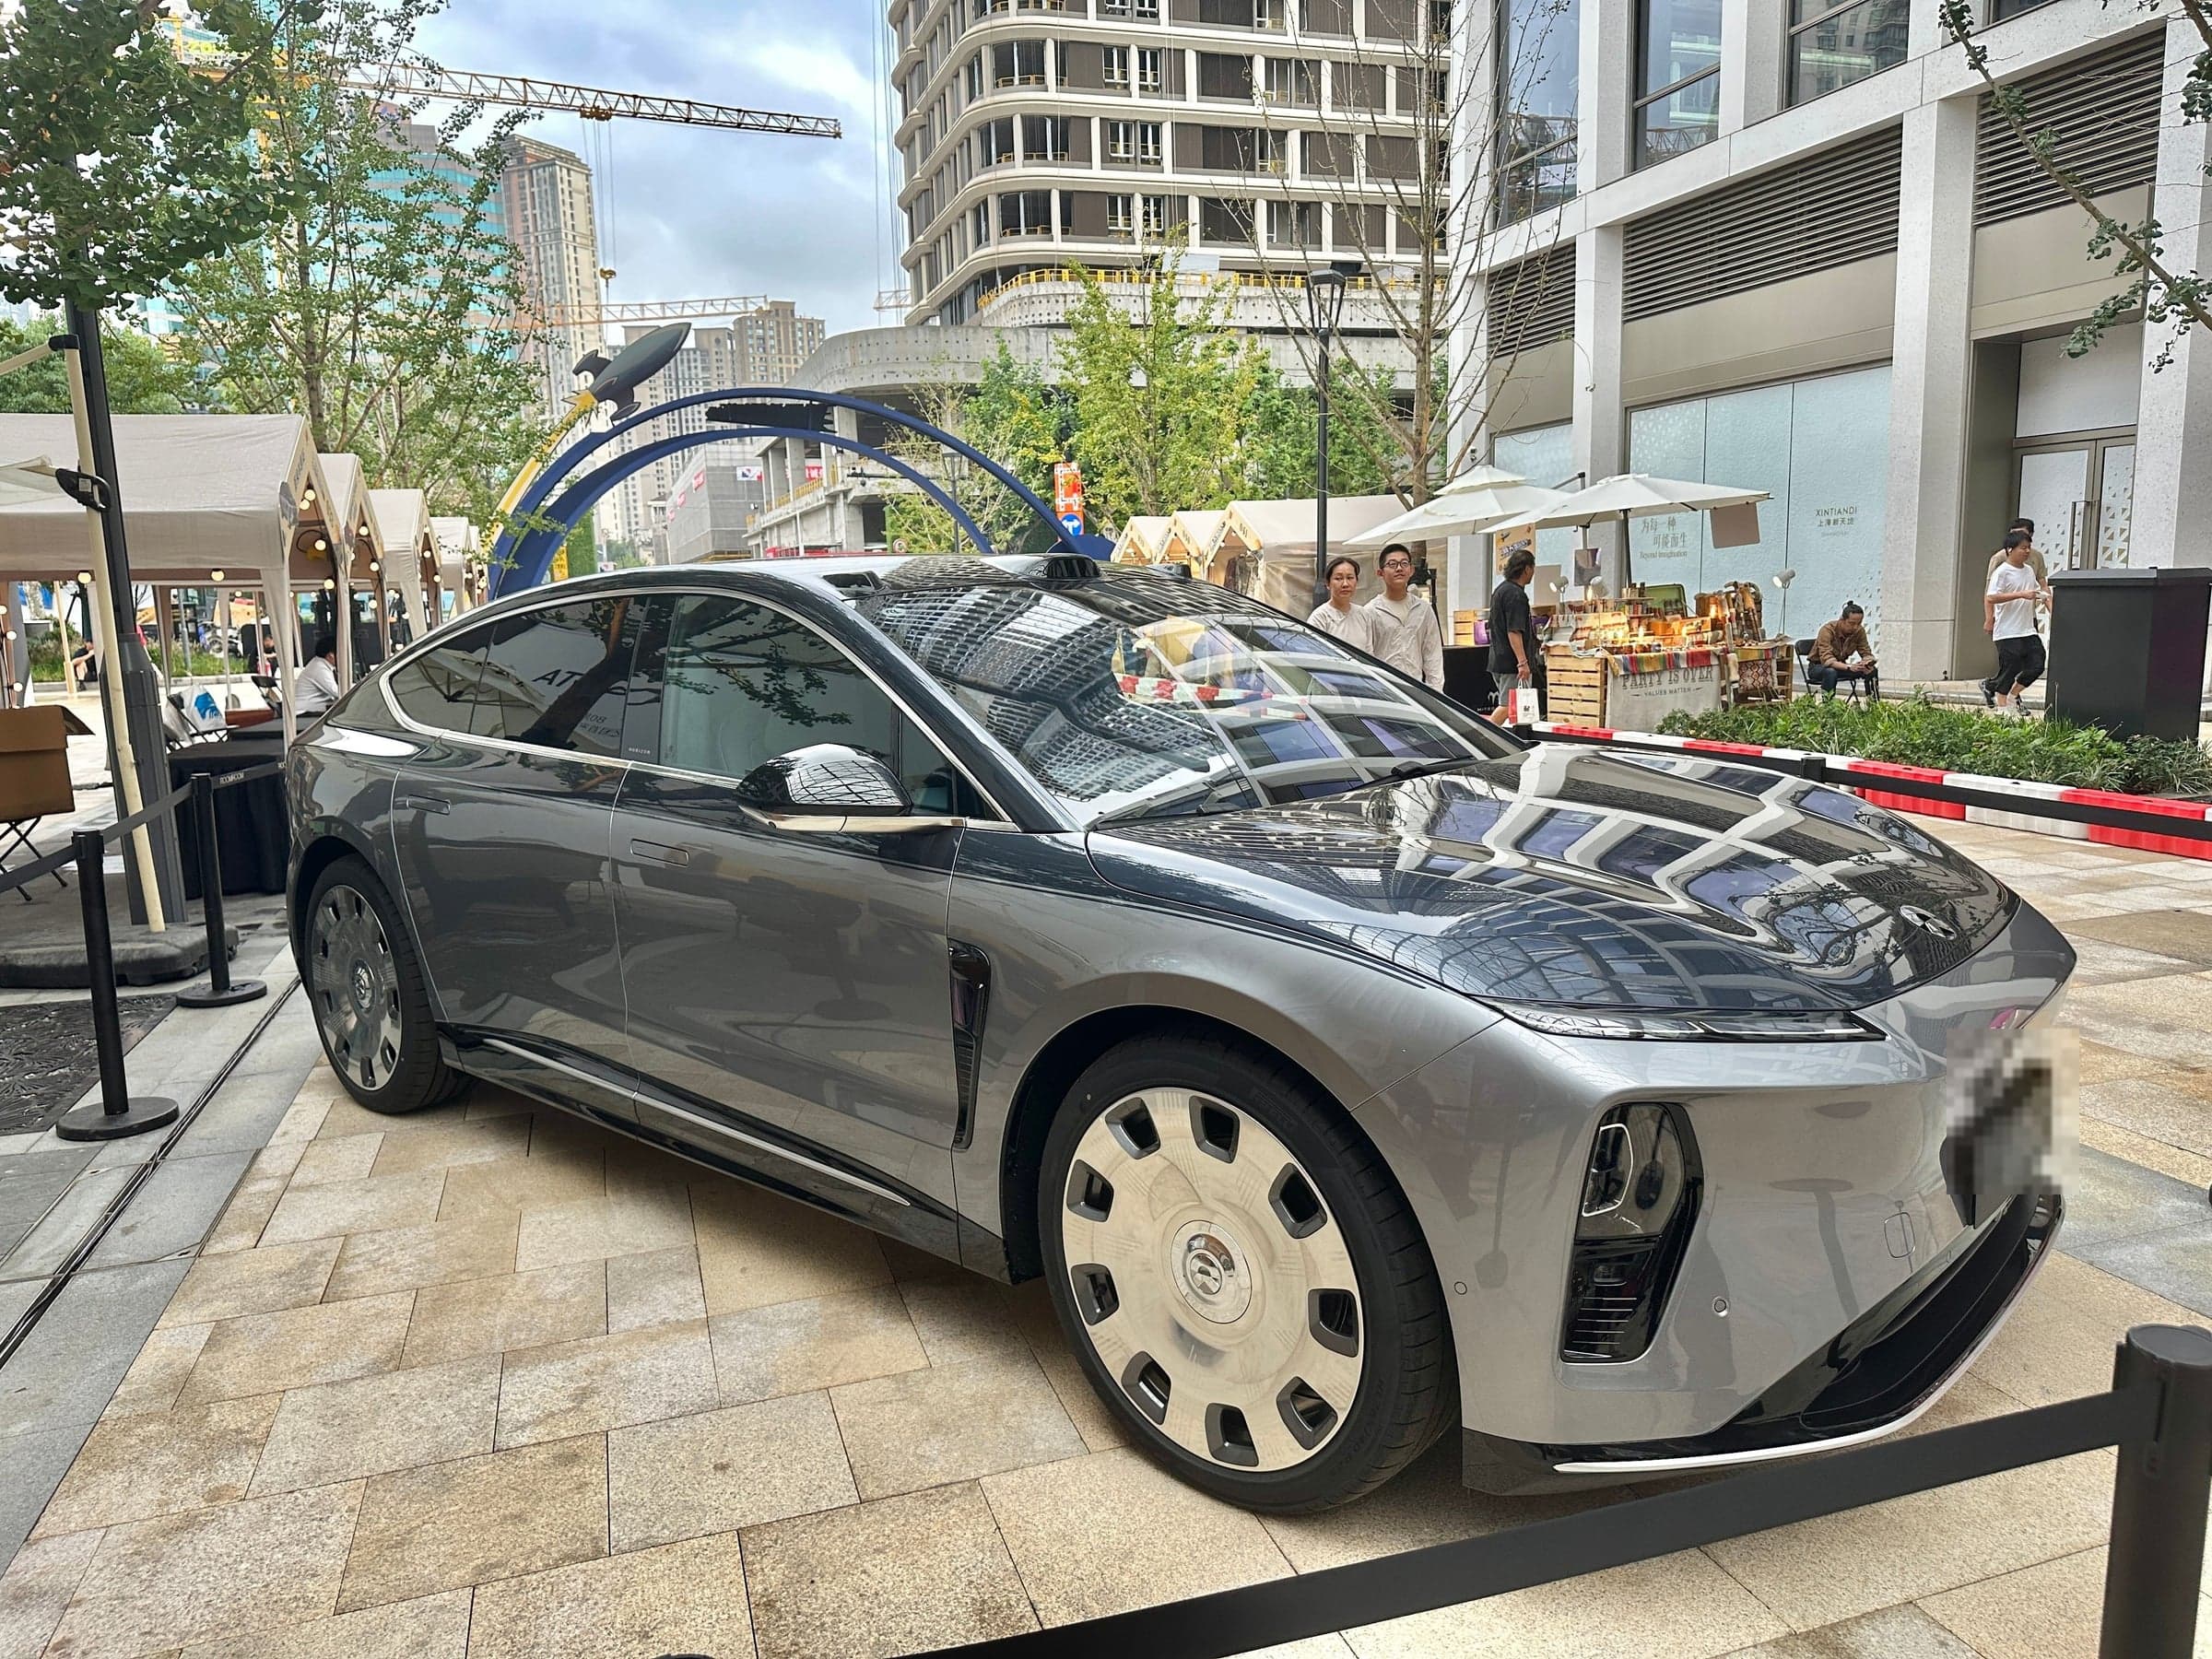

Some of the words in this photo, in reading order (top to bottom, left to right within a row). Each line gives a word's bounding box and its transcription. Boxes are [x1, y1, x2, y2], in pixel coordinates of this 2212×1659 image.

[1816, 506, 1857, 517] XINTIANDI
[1621, 670, 1663, 689] PARTY
[1668, 669, 1680, 685] IS
[1683, 666, 1713, 683] OVER
